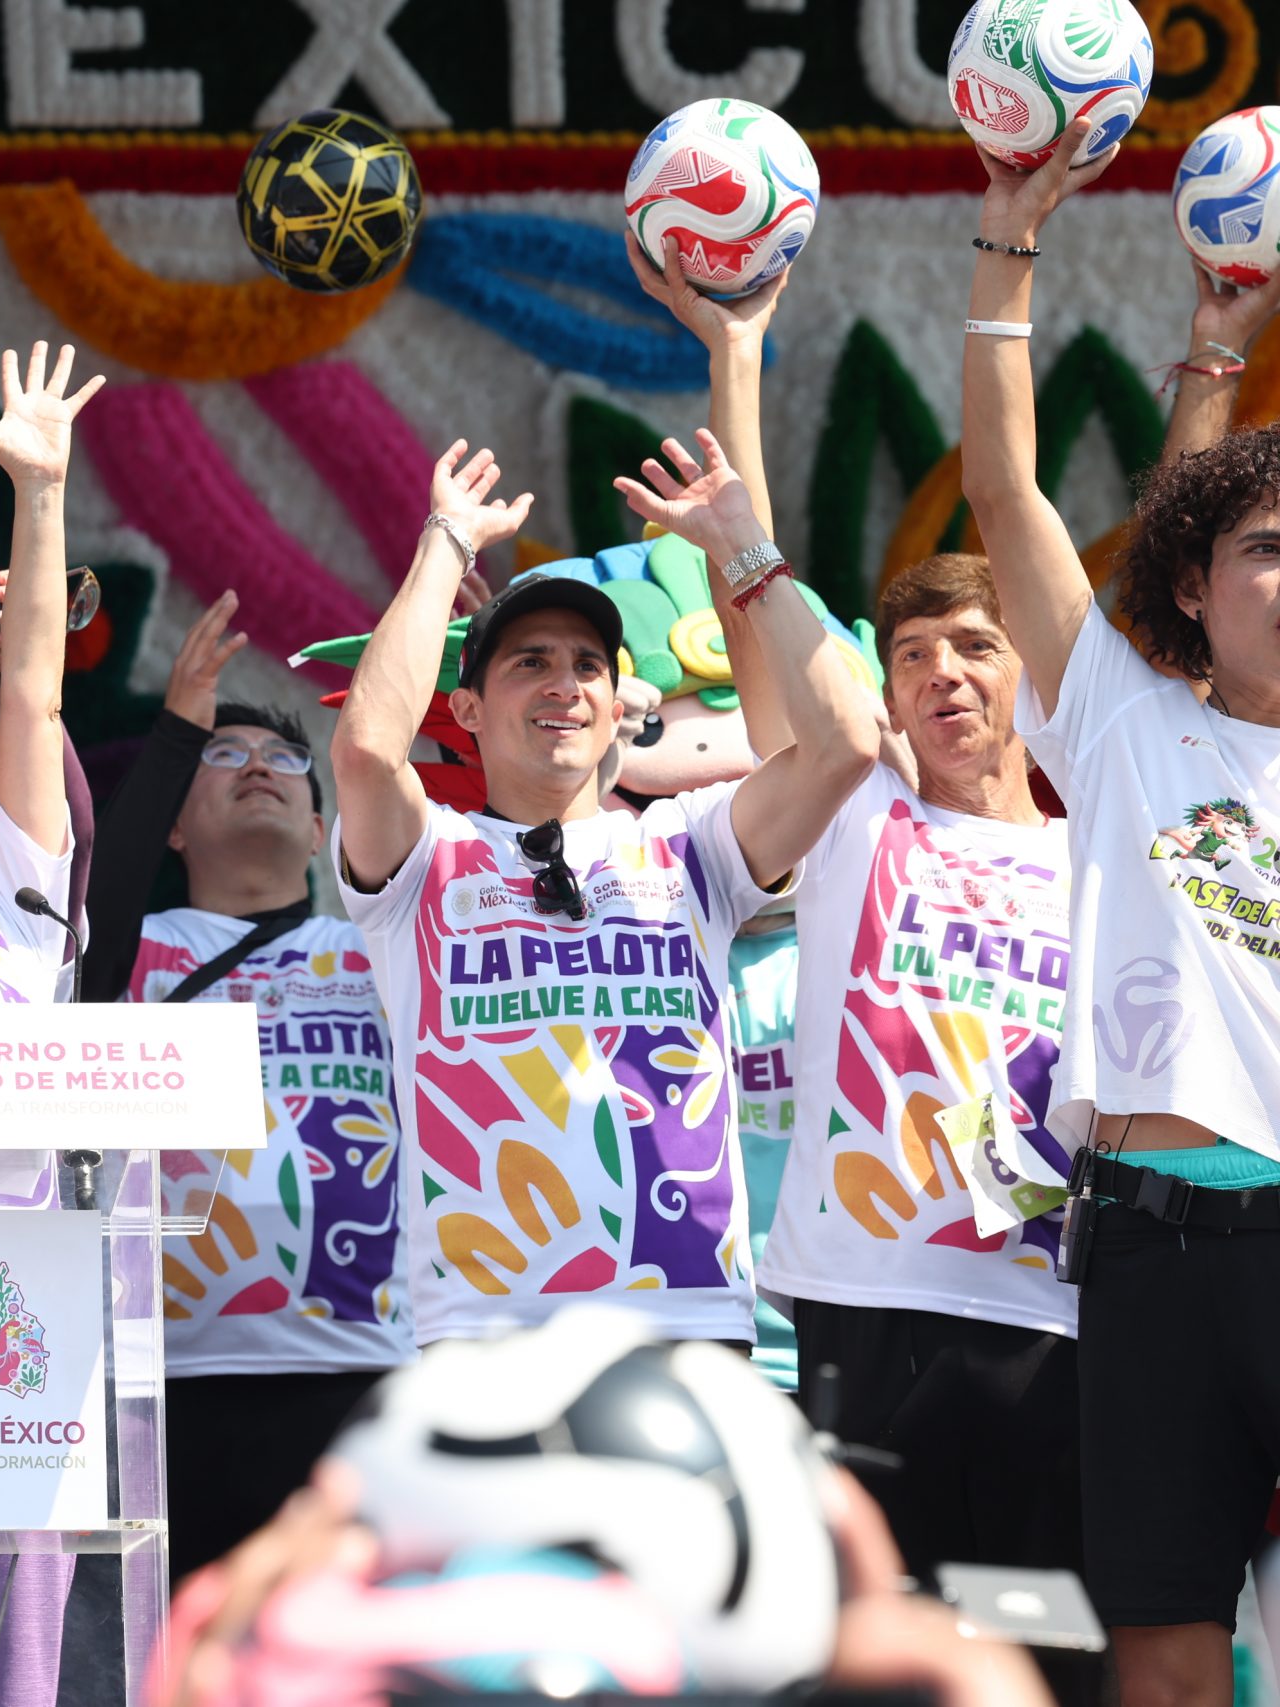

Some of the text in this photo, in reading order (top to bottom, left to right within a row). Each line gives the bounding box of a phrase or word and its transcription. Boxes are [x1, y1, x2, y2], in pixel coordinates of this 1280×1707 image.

[1229, 897, 1266, 926] DE
[450, 932, 694, 985] LA PELOTA
[1235, 932, 1268, 956] DEL
[893, 943, 995, 1010] VUVE
[1002, 988, 1027, 1018] A
[450, 985, 696, 1026] VUELVE A CASA
[81, 1042, 126, 1062] DE
[140, 1042, 182, 1062] LA
[15, 1071, 60, 1090] DE
[66, 1065, 185, 1090] MÉXICO
[280, 1064, 302, 1088] A
[311, 1064, 384, 1096] CASA
